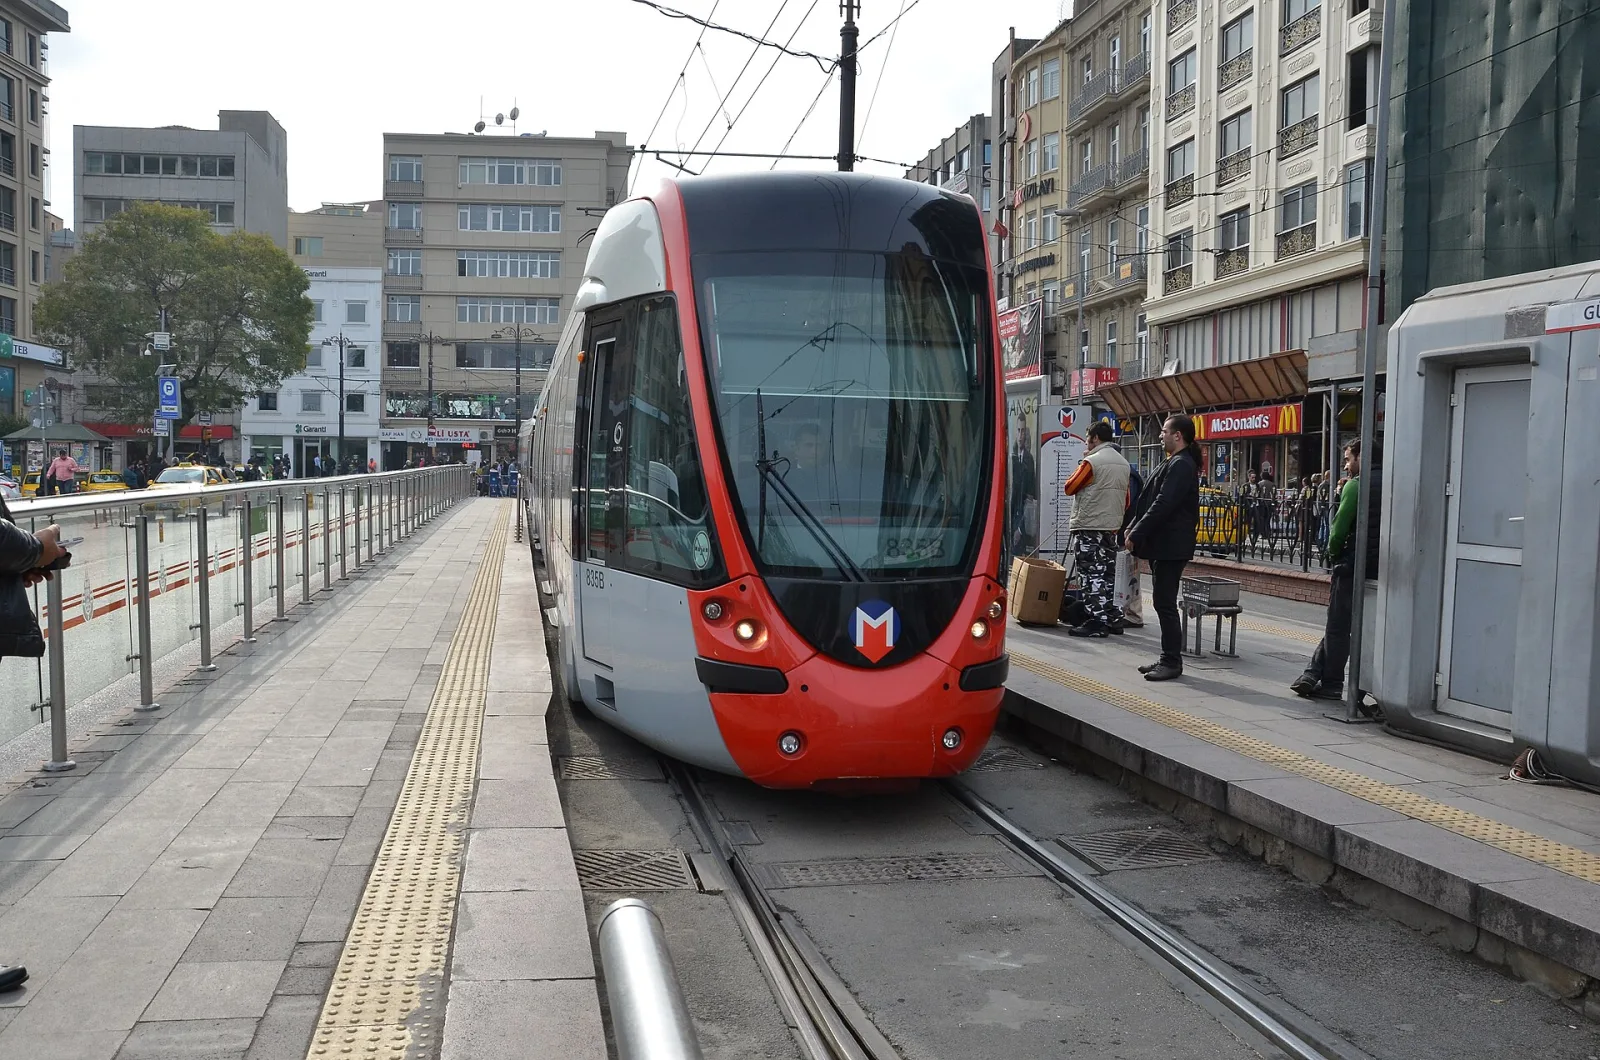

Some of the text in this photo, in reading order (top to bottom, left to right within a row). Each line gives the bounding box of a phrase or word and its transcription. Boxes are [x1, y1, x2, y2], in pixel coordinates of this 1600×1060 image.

[14, 345, 28, 355] TEB
[1008, 396, 1038, 416] ANGO
[303, 425, 327, 433] Garanti
[1211, 414, 1270, 433] McDonald's
[448, 430, 470, 438] USTA
[586, 568, 605, 589] 835B
